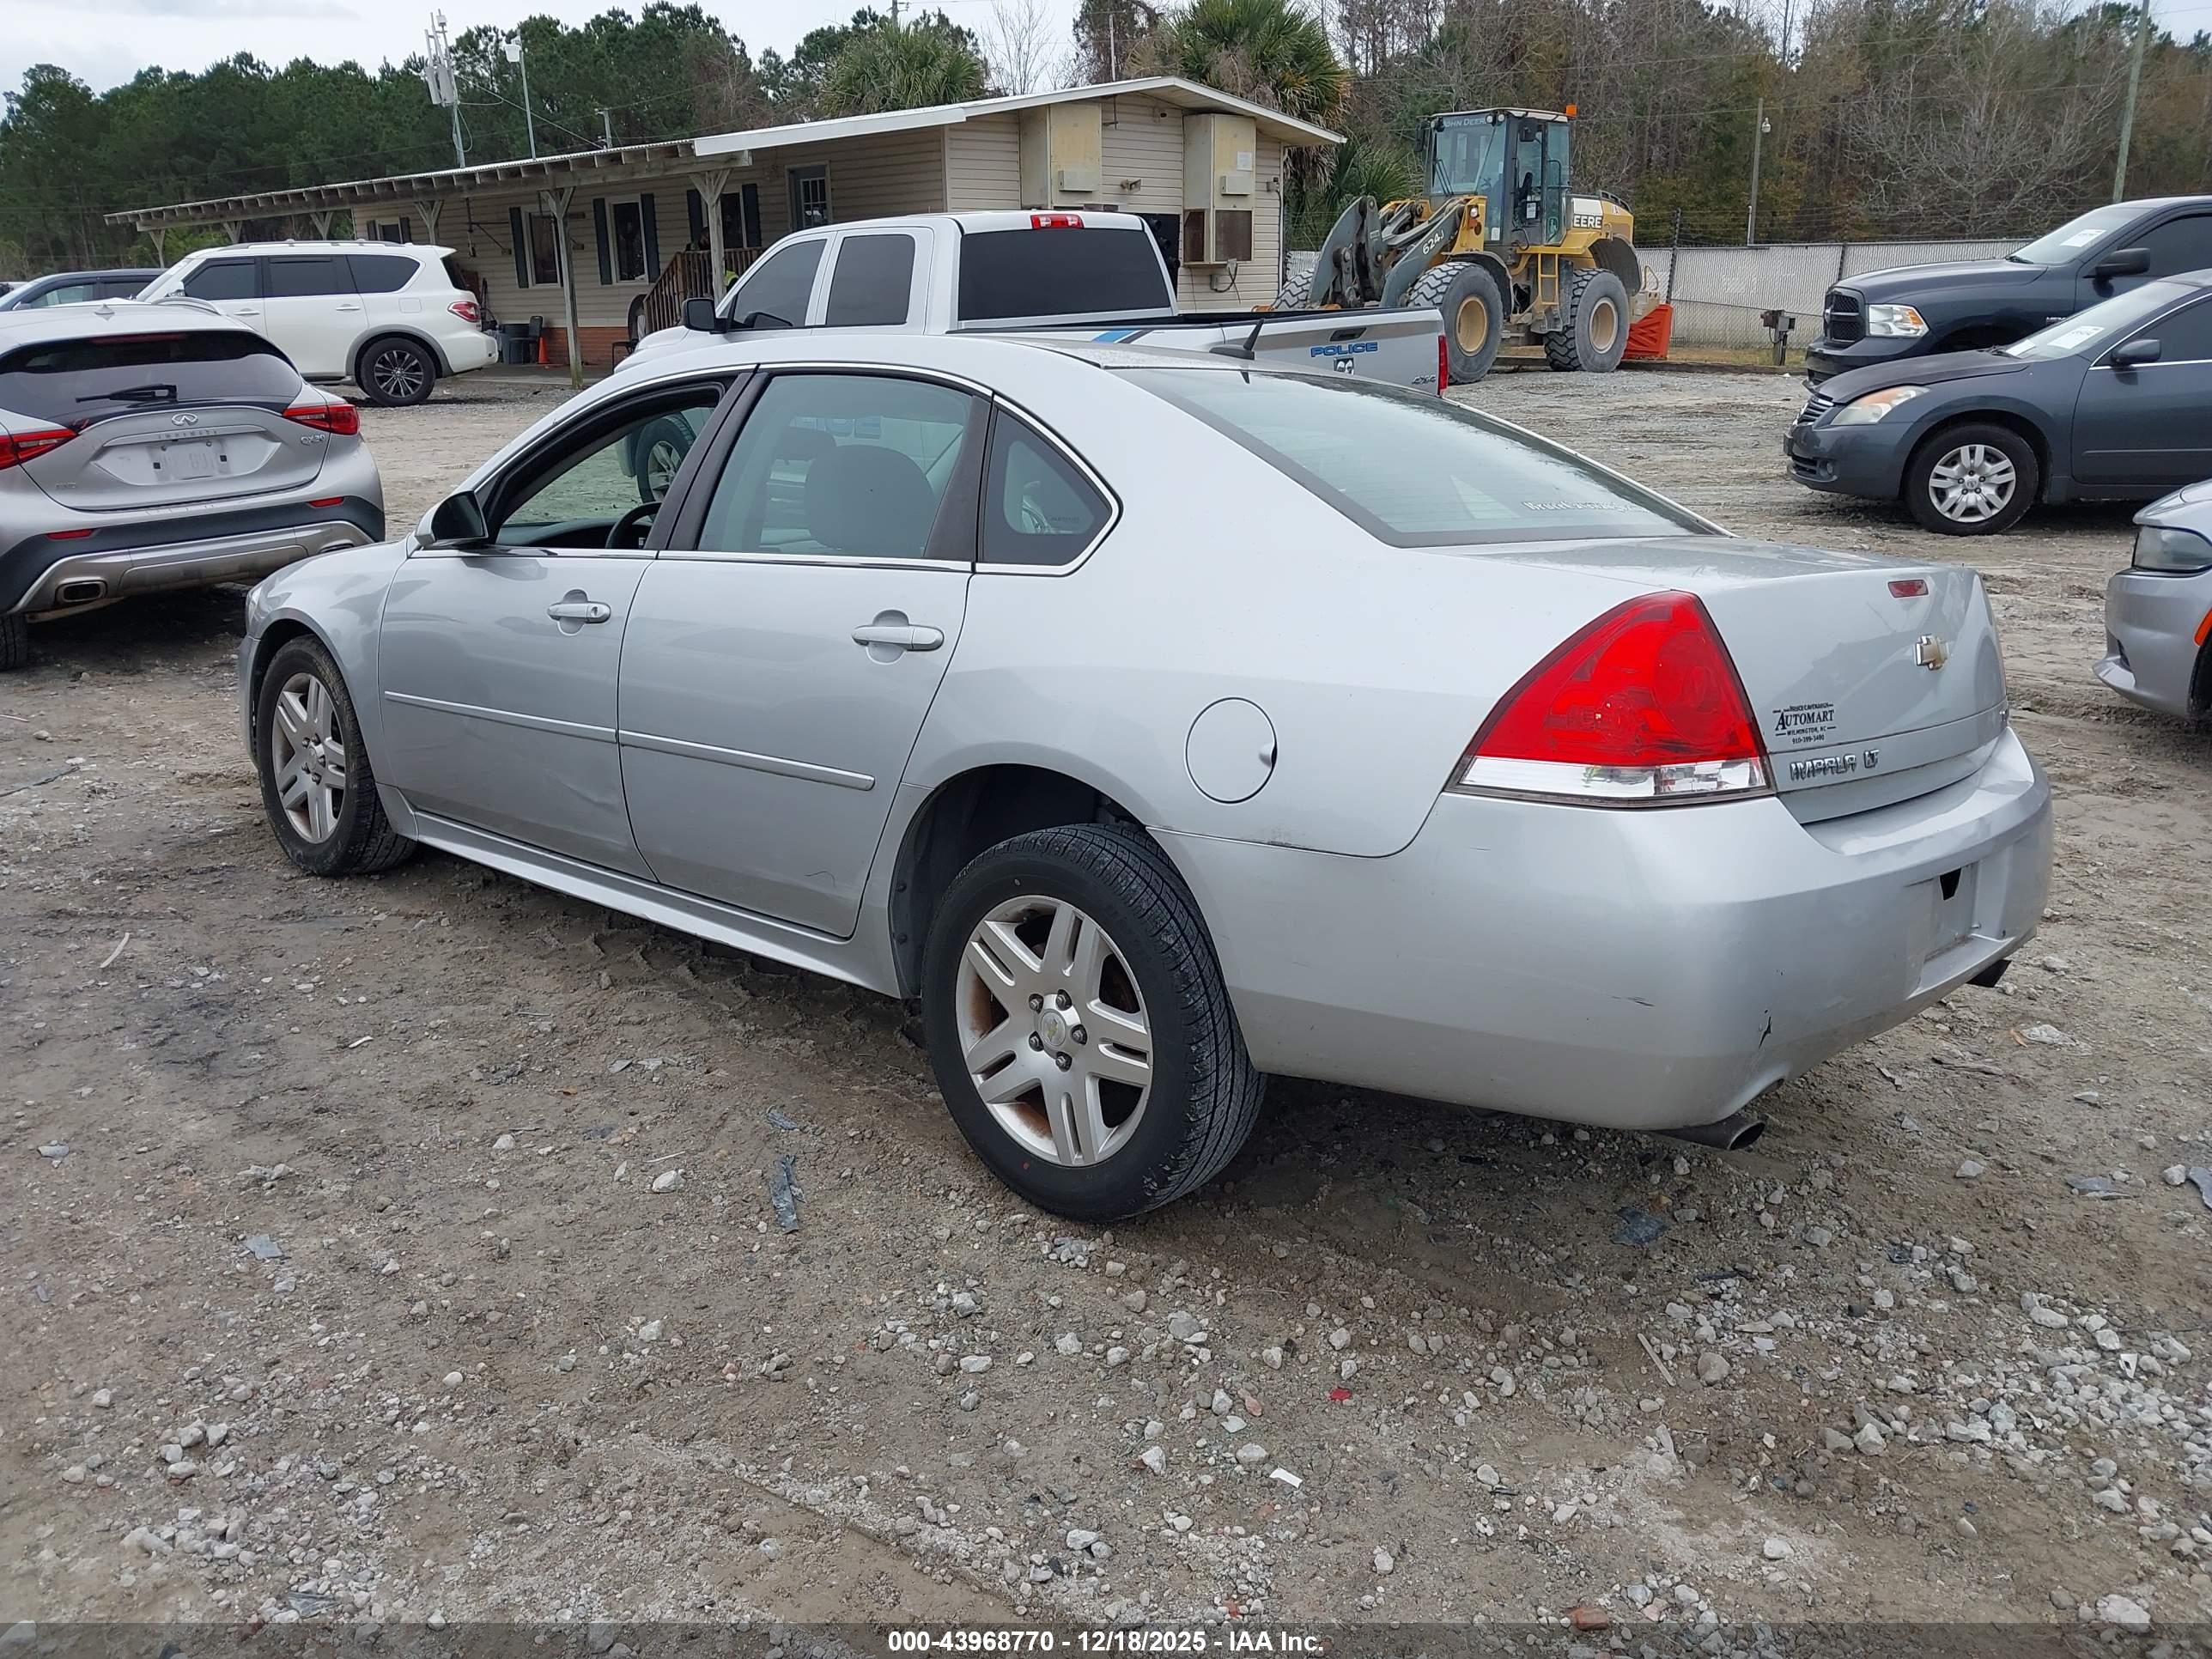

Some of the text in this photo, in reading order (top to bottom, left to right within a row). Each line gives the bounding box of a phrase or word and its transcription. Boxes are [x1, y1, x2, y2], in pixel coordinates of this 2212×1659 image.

[1573, 215, 1602, 228] EERE
[1422, 229, 1444, 255] 624J
[1310, 342, 1378, 358] POLICE
[1775, 708, 1835, 731] AUTOMART
[1790, 749, 1880, 781] IMPALA LT
